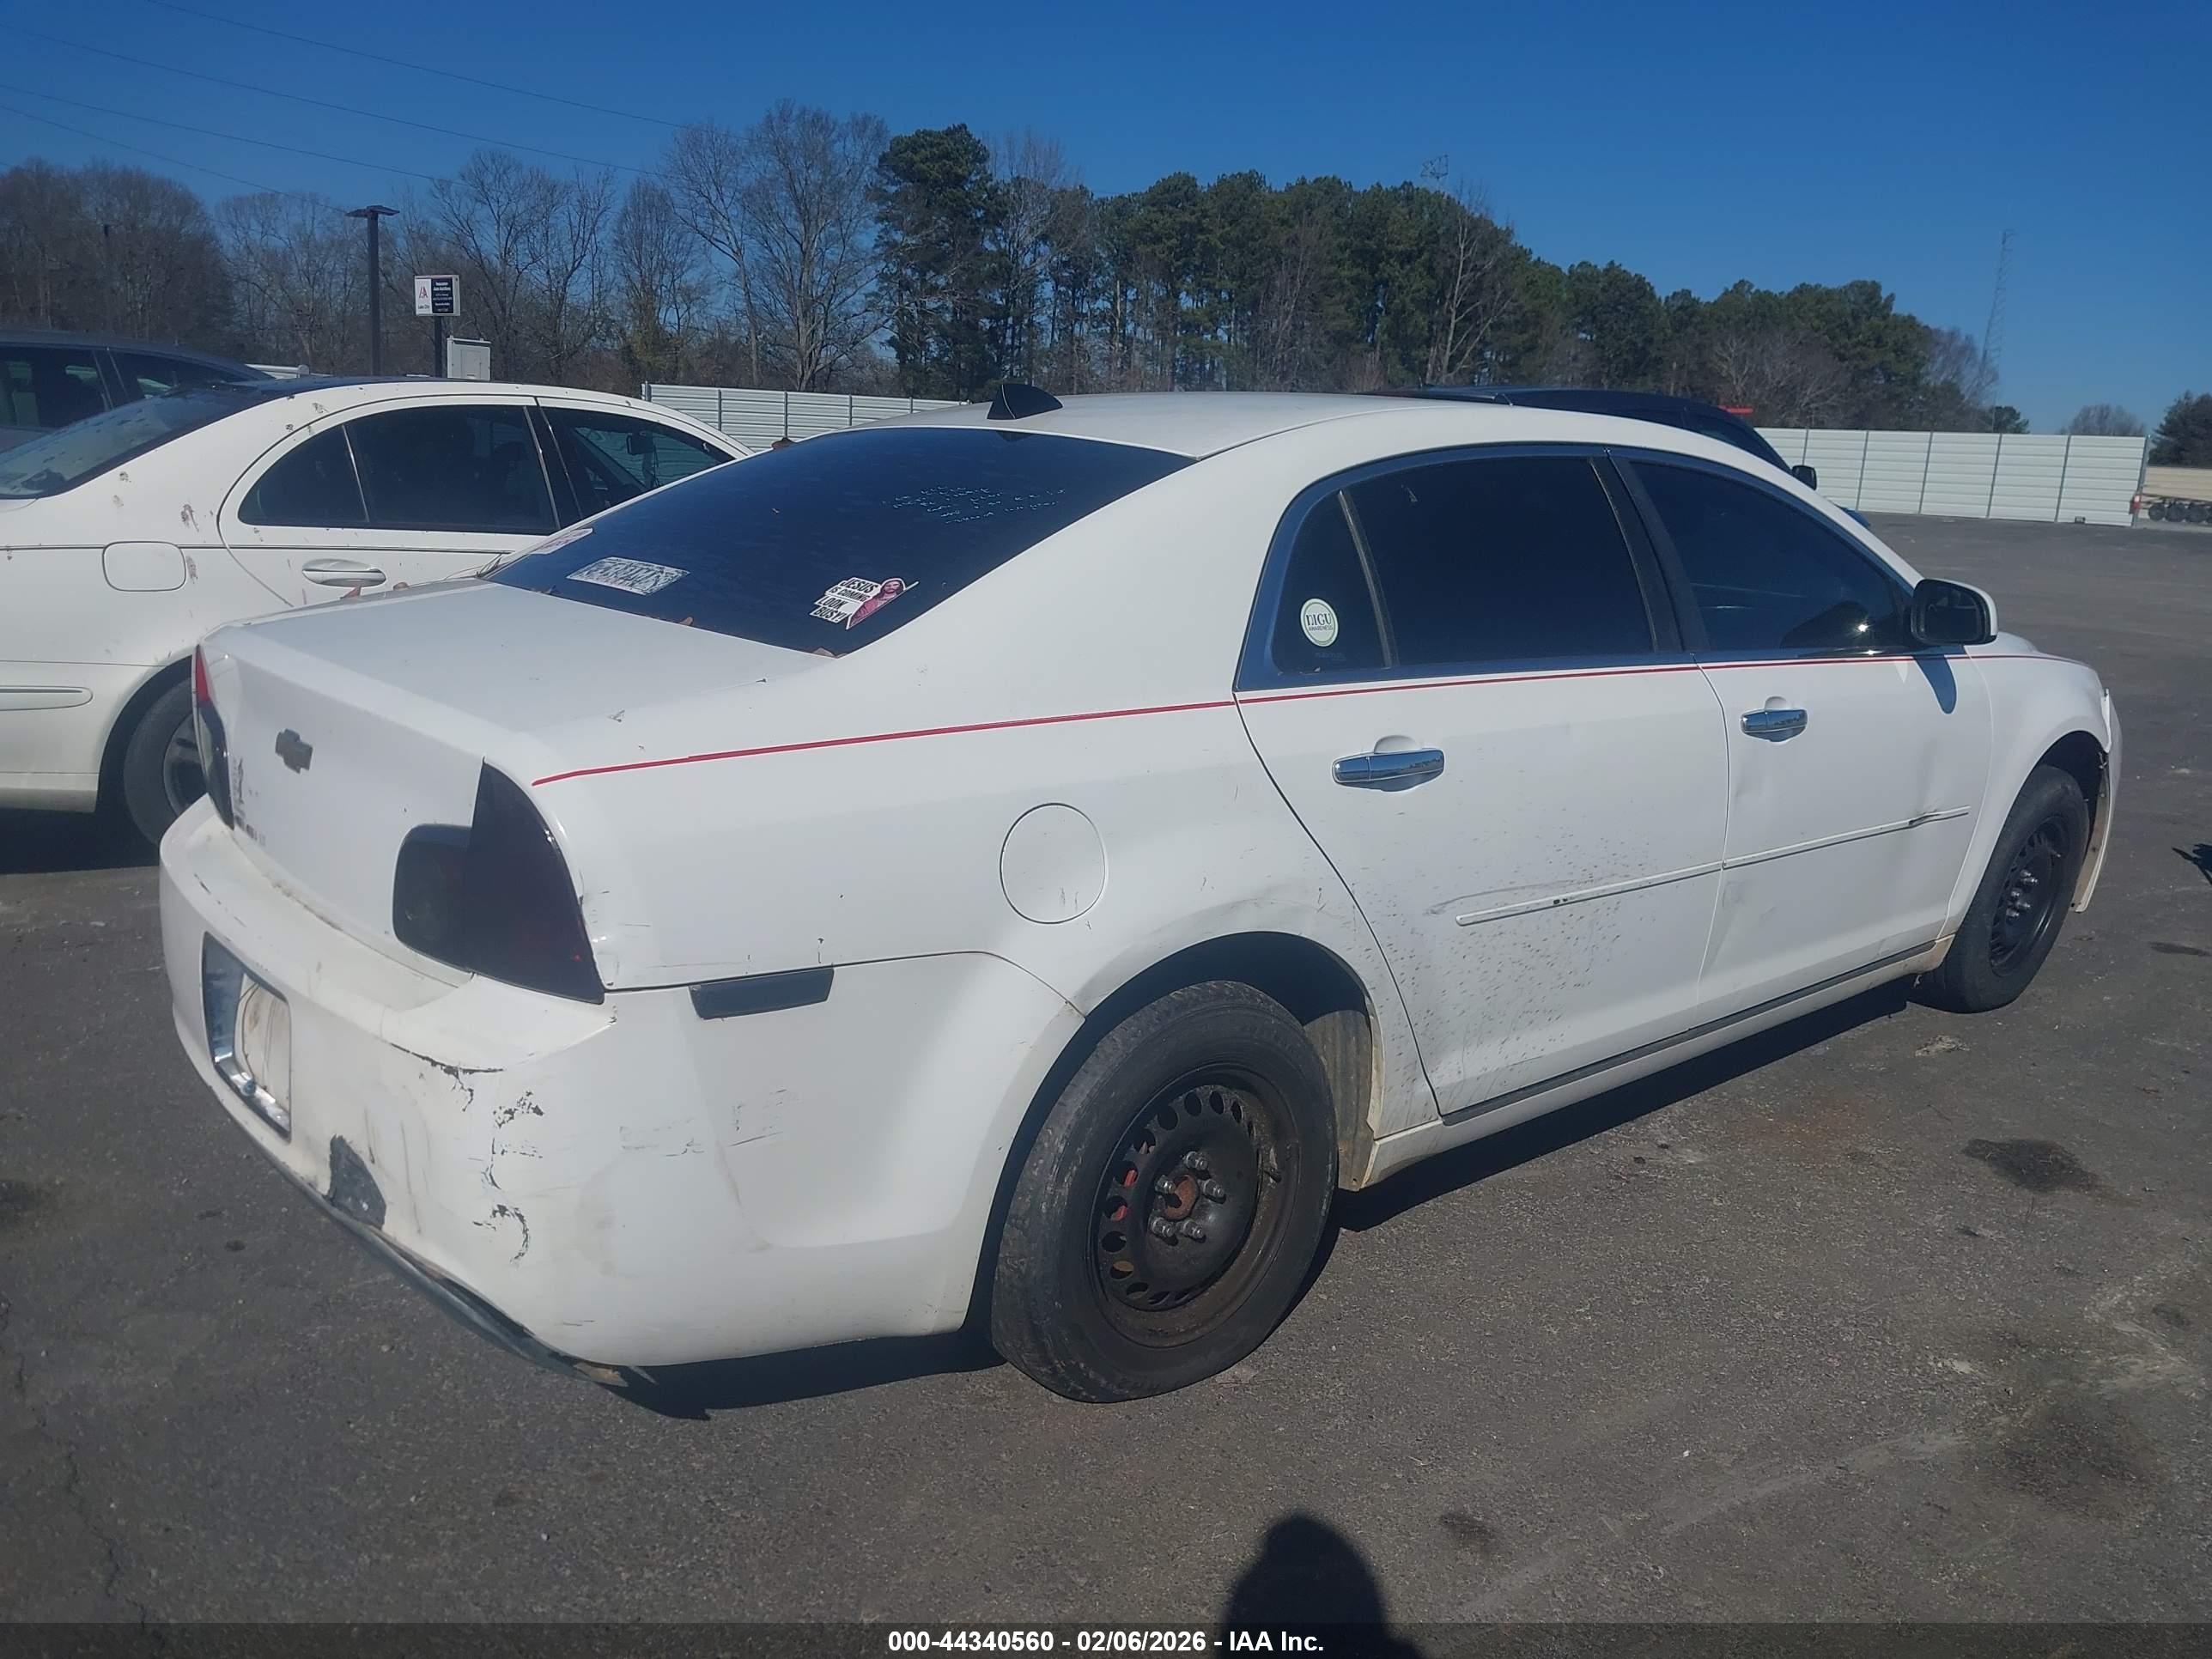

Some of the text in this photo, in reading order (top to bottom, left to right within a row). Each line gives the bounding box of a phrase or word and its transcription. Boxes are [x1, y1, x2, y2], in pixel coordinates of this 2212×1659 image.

[841, 579, 878, 593] JESUS
[840, 588, 870, 601] COMING
[818, 596, 847, 609] LOOK
[814, 606, 848, 622] BUSY!
